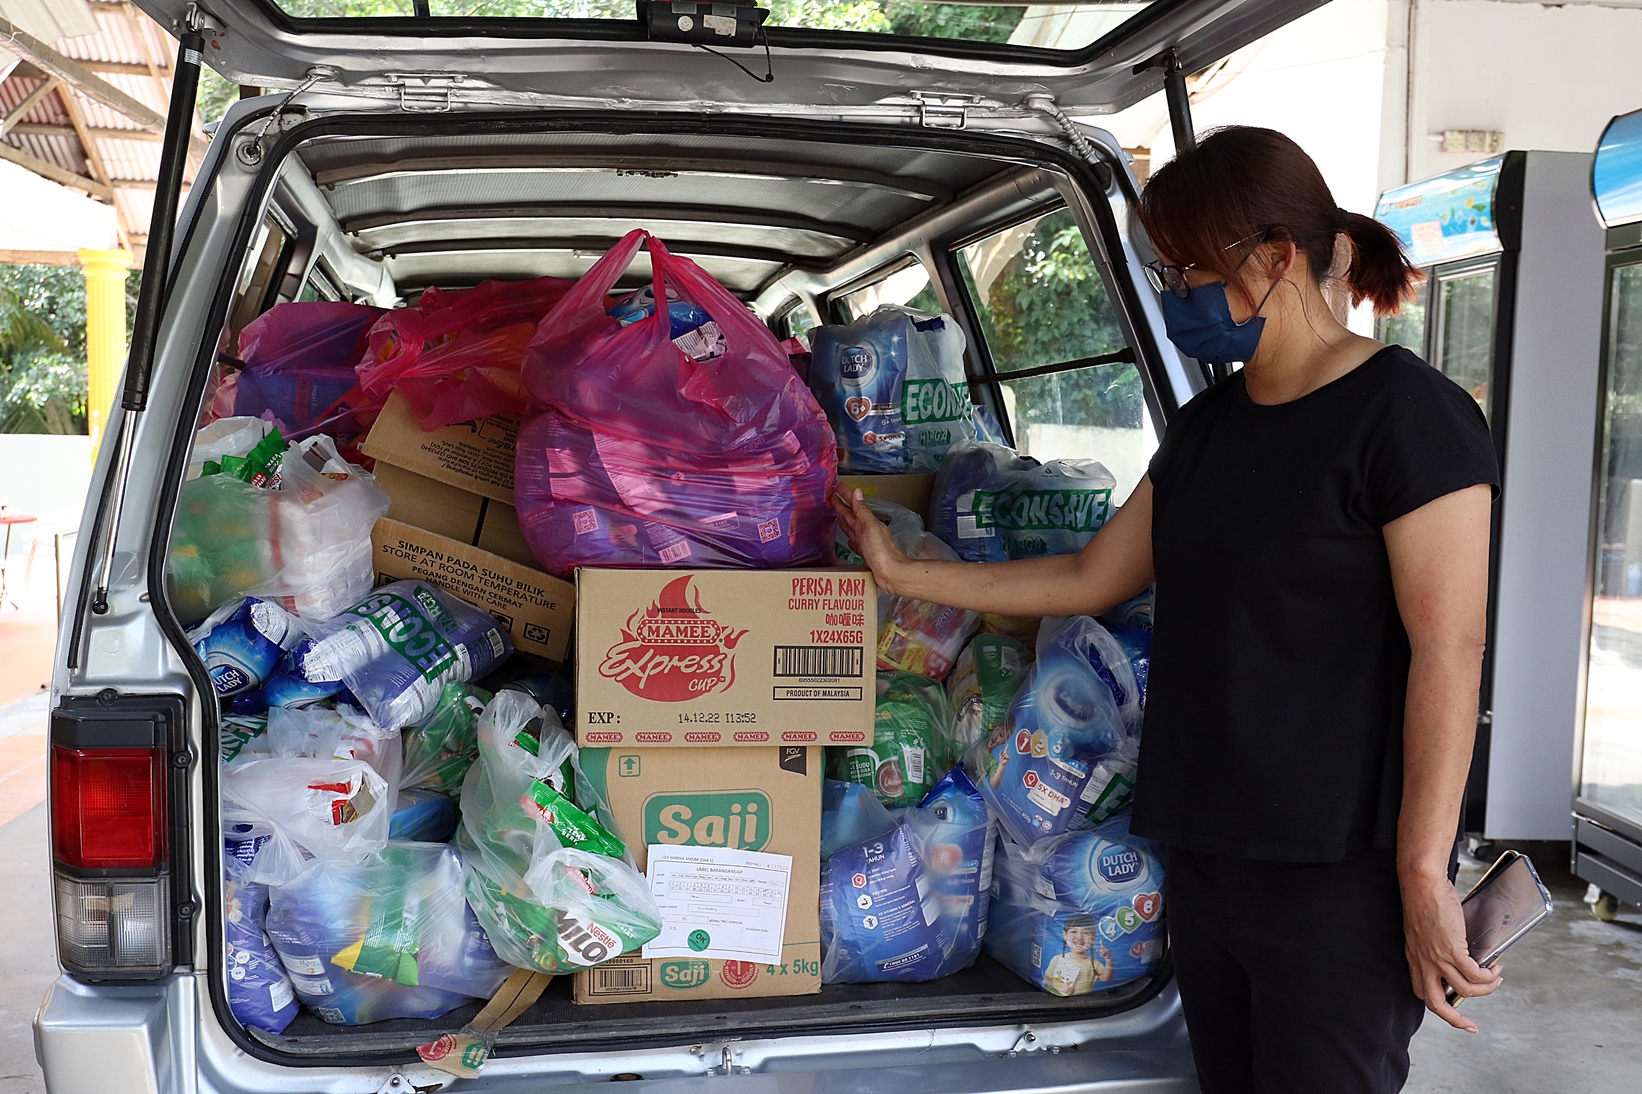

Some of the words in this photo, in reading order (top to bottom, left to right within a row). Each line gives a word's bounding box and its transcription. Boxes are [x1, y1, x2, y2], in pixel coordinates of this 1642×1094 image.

[842, 355, 867, 364] DUTCH
[844, 364, 864, 372] LADY
[979, 492, 1106, 527] ECONSAVE
[1002, 536, 1042, 551] HARGA
[398, 541, 444, 560] SIMPAN
[447, 556, 478, 573] PADA
[482, 568, 514, 585] SUHU
[516, 581, 545, 597] BILIK
[383, 545, 417, 562] STORE
[420, 558, 437, 569] AT
[439, 564, 474, 580] ROOM
[478, 575, 556, 610] TEMPERATURE
[412, 566, 448, 581] PEGANG
[450, 578, 486, 594] DENGAN
[489, 591, 523, 609] CERMAT
[426, 577, 461, 592] HANDLE
[462, 588, 485, 600] WITH
[486, 597, 508, 610] CARE
[792, 578, 833, 596] PERISA
[839, 578, 865, 596] KARI
[788, 599, 819, 610] CURRY
[822, 599, 864, 610] FLAVOUR
[358, 595, 452, 673] ECONS
[648, 625, 711, 638] MAMEE
[810, 630, 863, 644] 1X24X65G
[600, 643, 726, 689] Express
[213, 670, 240, 684] UTCH
[217, 678, 242, 691] LADY
[688, 677, 718, 692] CUP
[786, 689, 812, 697] PRODUCT
[814, 689, 820, 697] OF
[822, 689, 850, 697] MALAYSIA
[588, 712, 621, 724] EXP:
[678, 713, 720, 723] 14.12.22
[1050, 769, 1061, 780] 1-3
[1061, 775, 1078, 788] TAHUN
[1038, 784, 1047, 794] 5X
[657, 803, 758, 850] Saji
[863, 843, 884, 858] 1-3
[867, 854, 885, 863] AHUN
[1103, 852, 1137, 866] DUTCH
[1108, 863, 1136, 876] LADY
[1106, 923, 1116, 936] 4
[1125, 912, 1134, 926] 5
[1143, 900, 1153, 914] 6
[557, 907, 608, 962] MILO
[696, 933, 706, 944] OK
[664, 964, 705, 986] Saji
[766, 964, 776, 976] 4
[780, 965, 788, 975] x
[793, 960, 818, 977] 5kg
